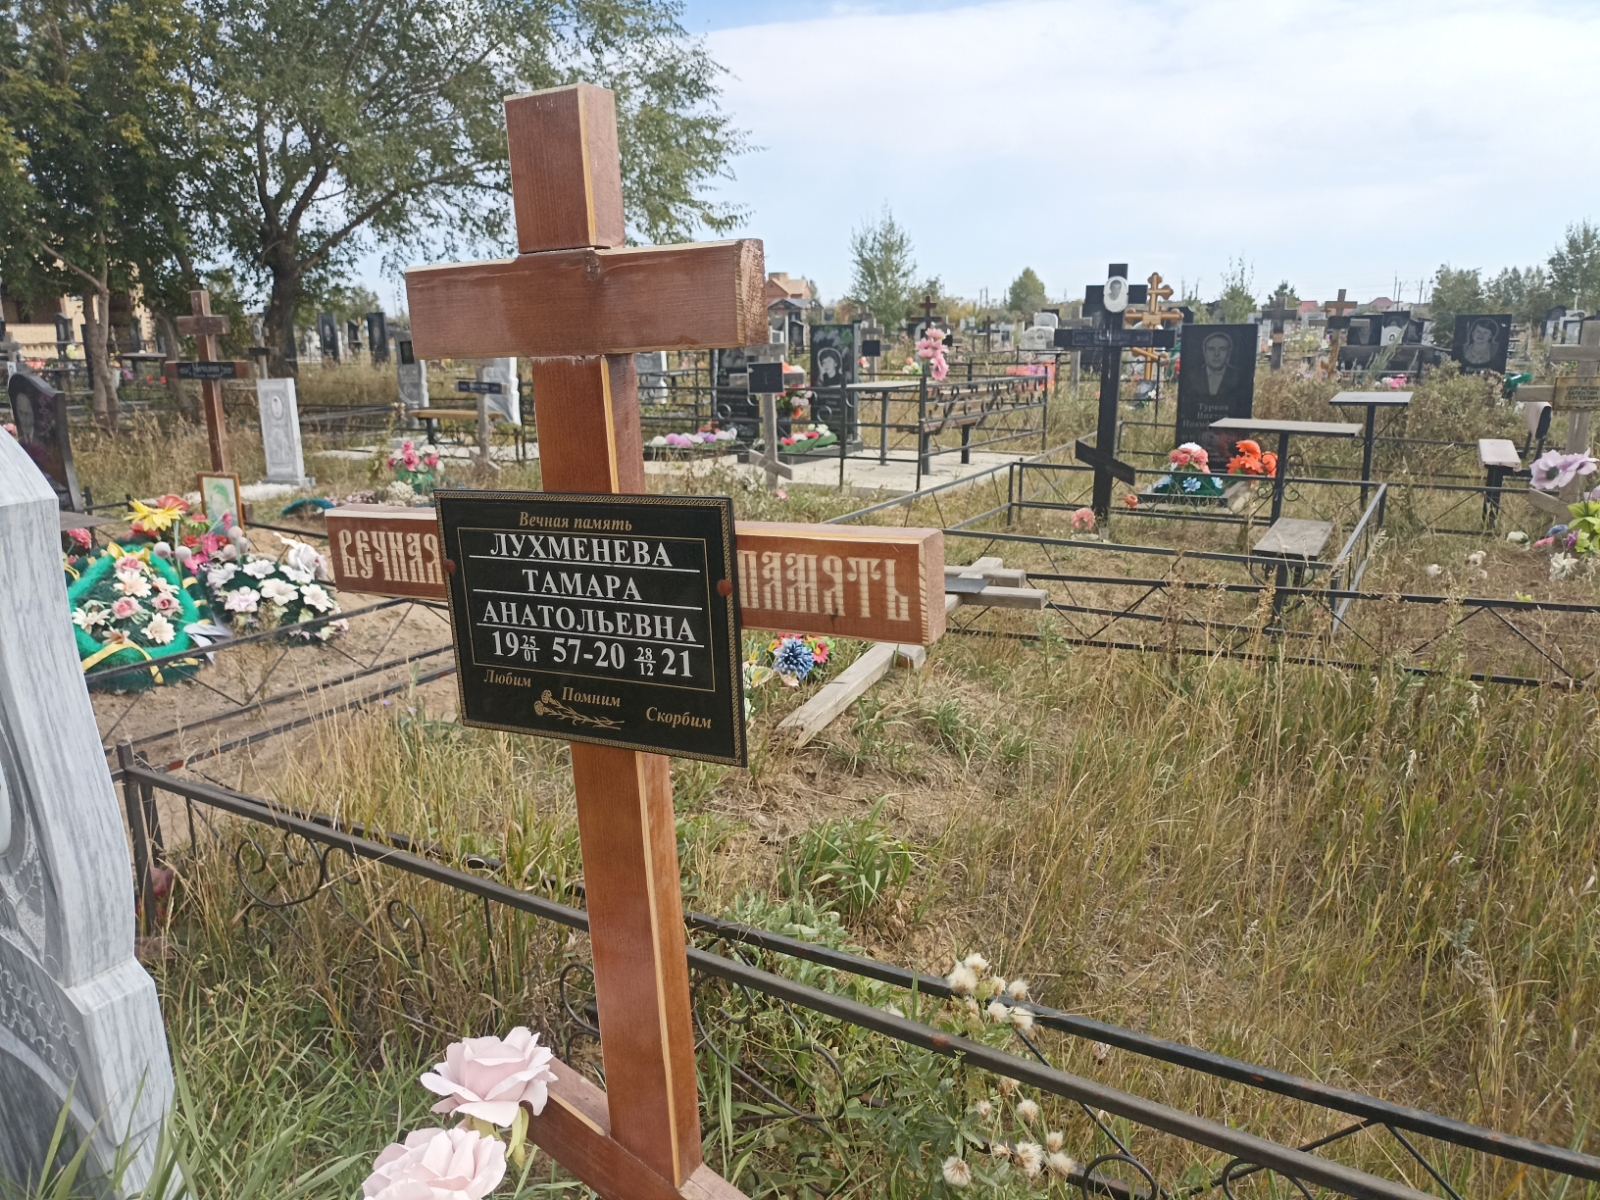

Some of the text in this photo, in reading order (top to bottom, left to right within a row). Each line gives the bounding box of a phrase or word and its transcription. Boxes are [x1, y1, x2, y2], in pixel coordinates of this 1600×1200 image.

[519, 511, 633, 531] Вечная память
[490, 532, 673, 567] ЛУХМЕНЕВА
[522, 569, 642, 601] ТАМАРА
[482, 600, 696, 642] АНАТОЛЬЕВНА
[522, 635, 653, 661] 25 28
[523, 649, 654, 677] 01 12
[661, 648, 693, 678] 21
[483, 669, 532, 688] Любим
[561, 686, 621, 707] Помним
[645, 706, 712, 729] Скорбим
